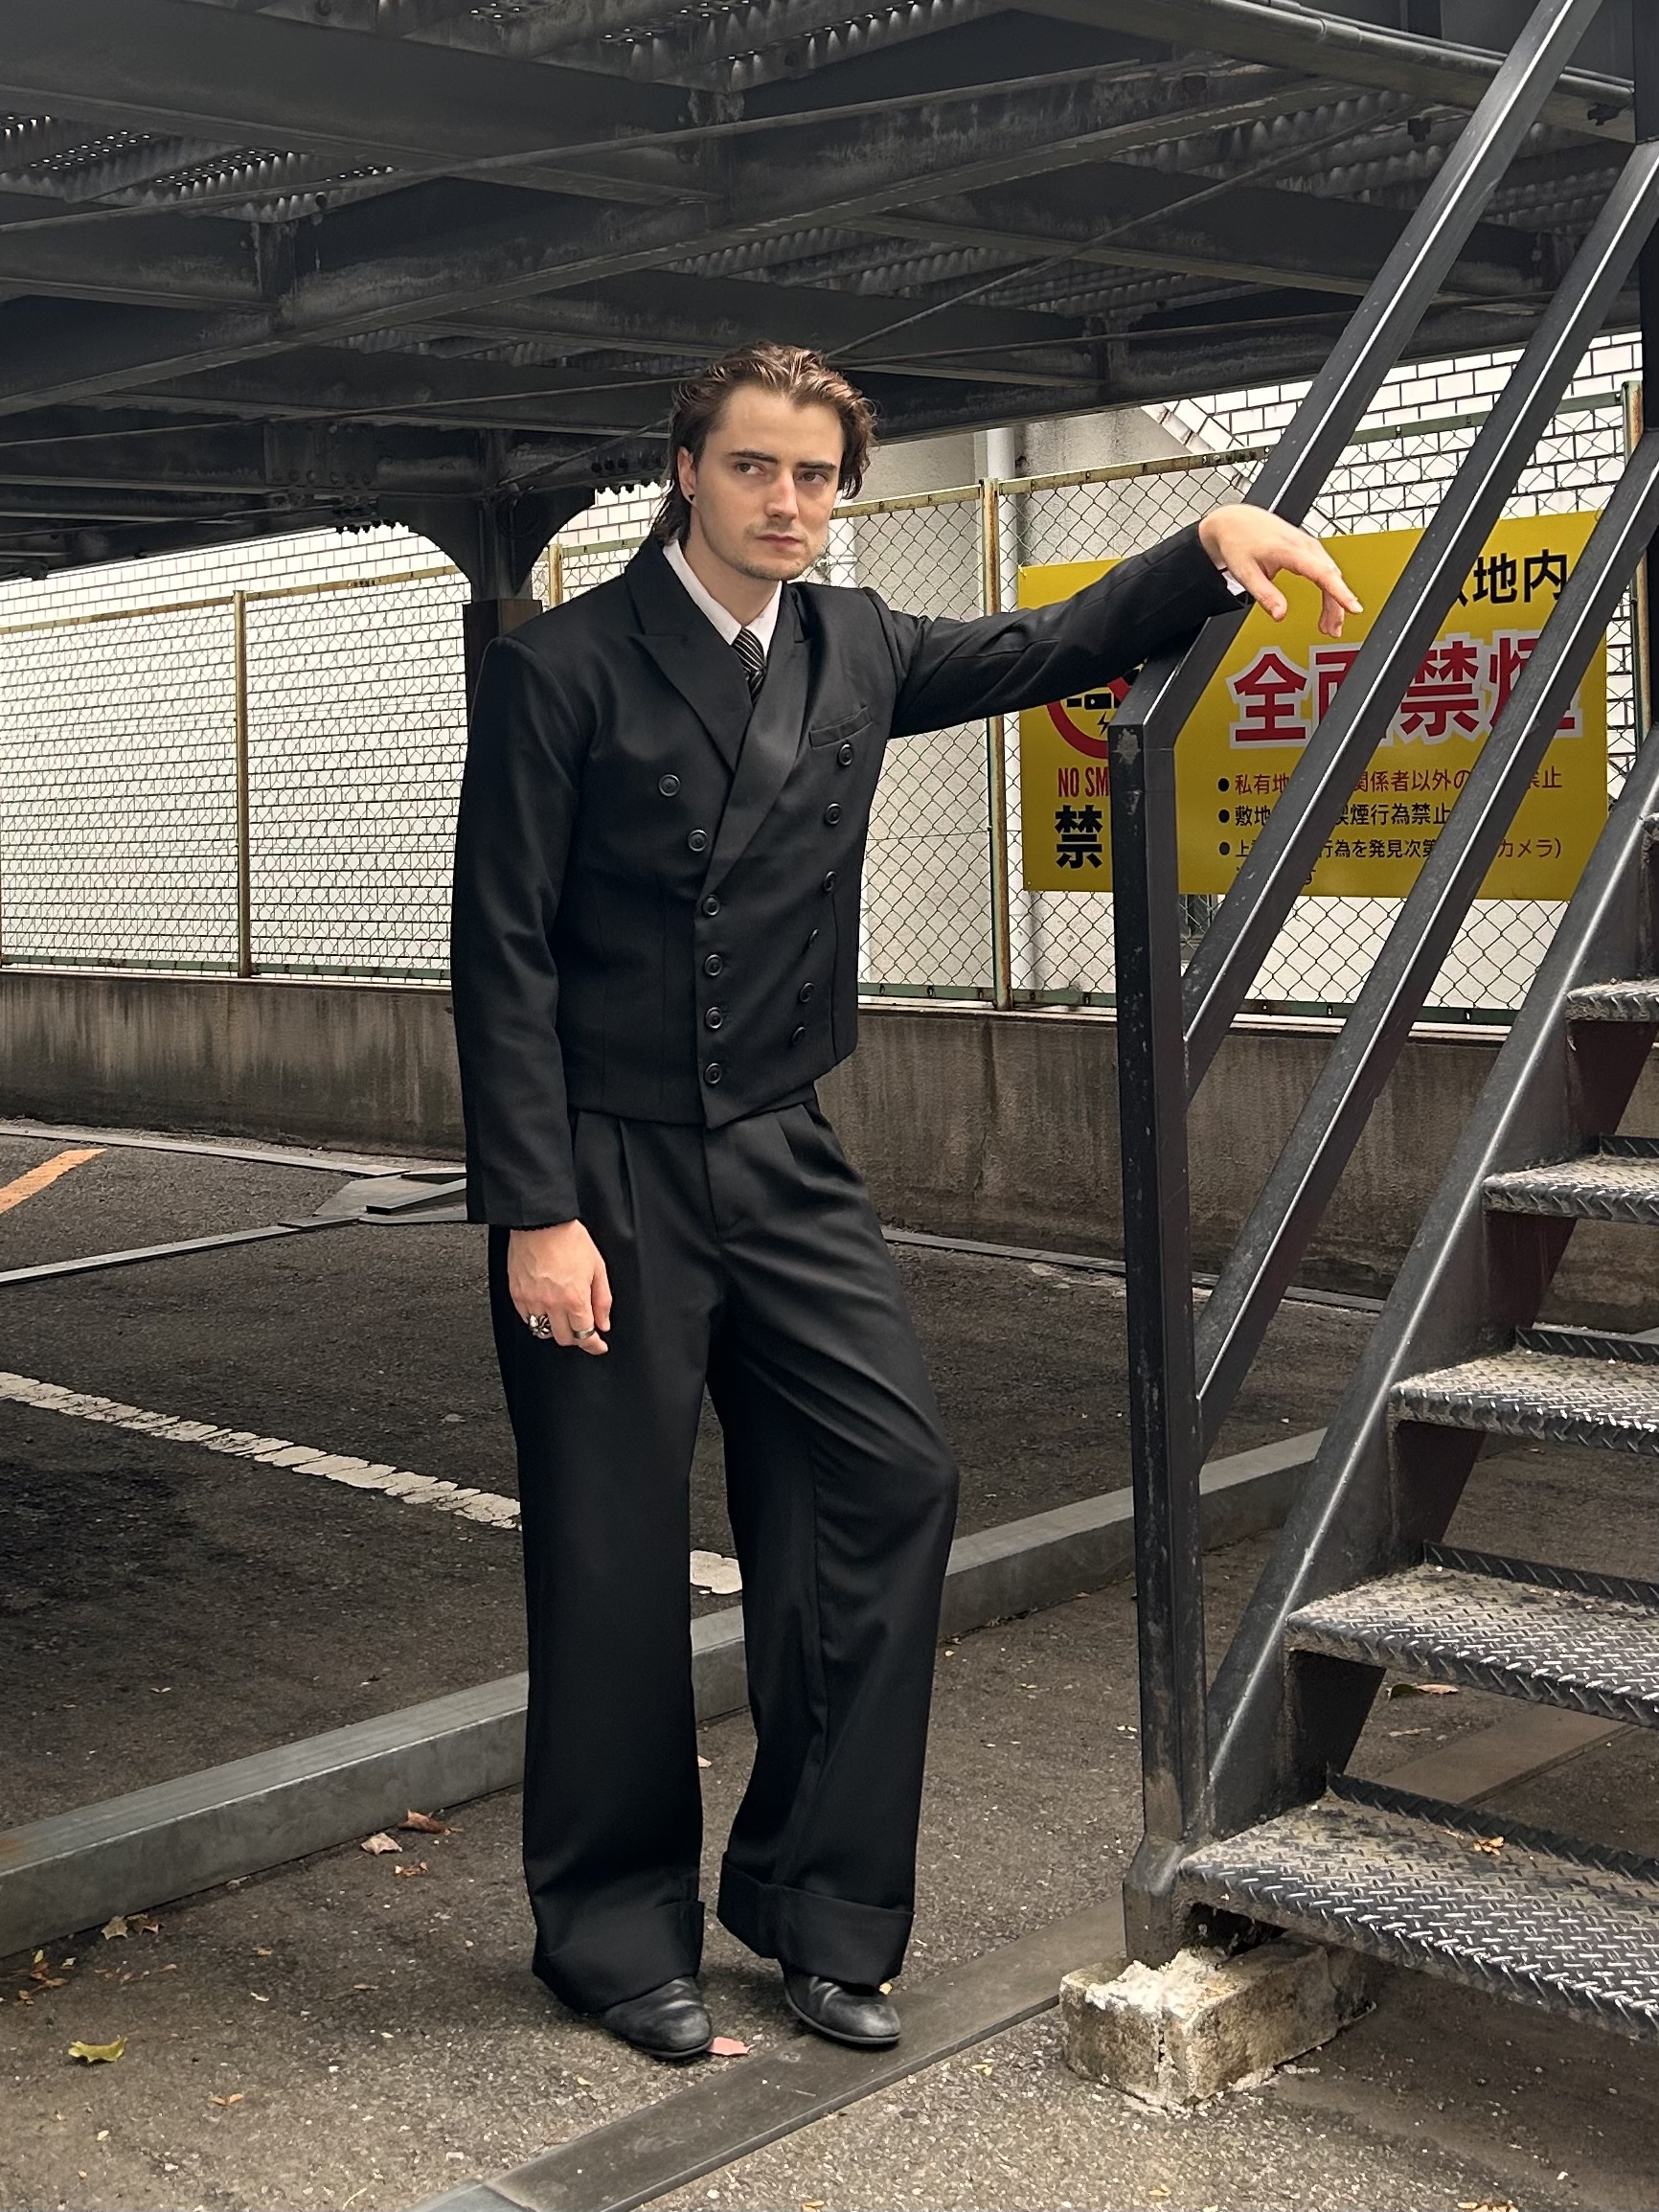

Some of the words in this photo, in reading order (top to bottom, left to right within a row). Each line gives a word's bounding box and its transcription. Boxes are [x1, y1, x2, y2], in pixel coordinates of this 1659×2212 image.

[1457, 549, 1568, 607] 地内
[1057, 766, 1080, 798] NO
[1055, 804, 1102, 870] 禁
